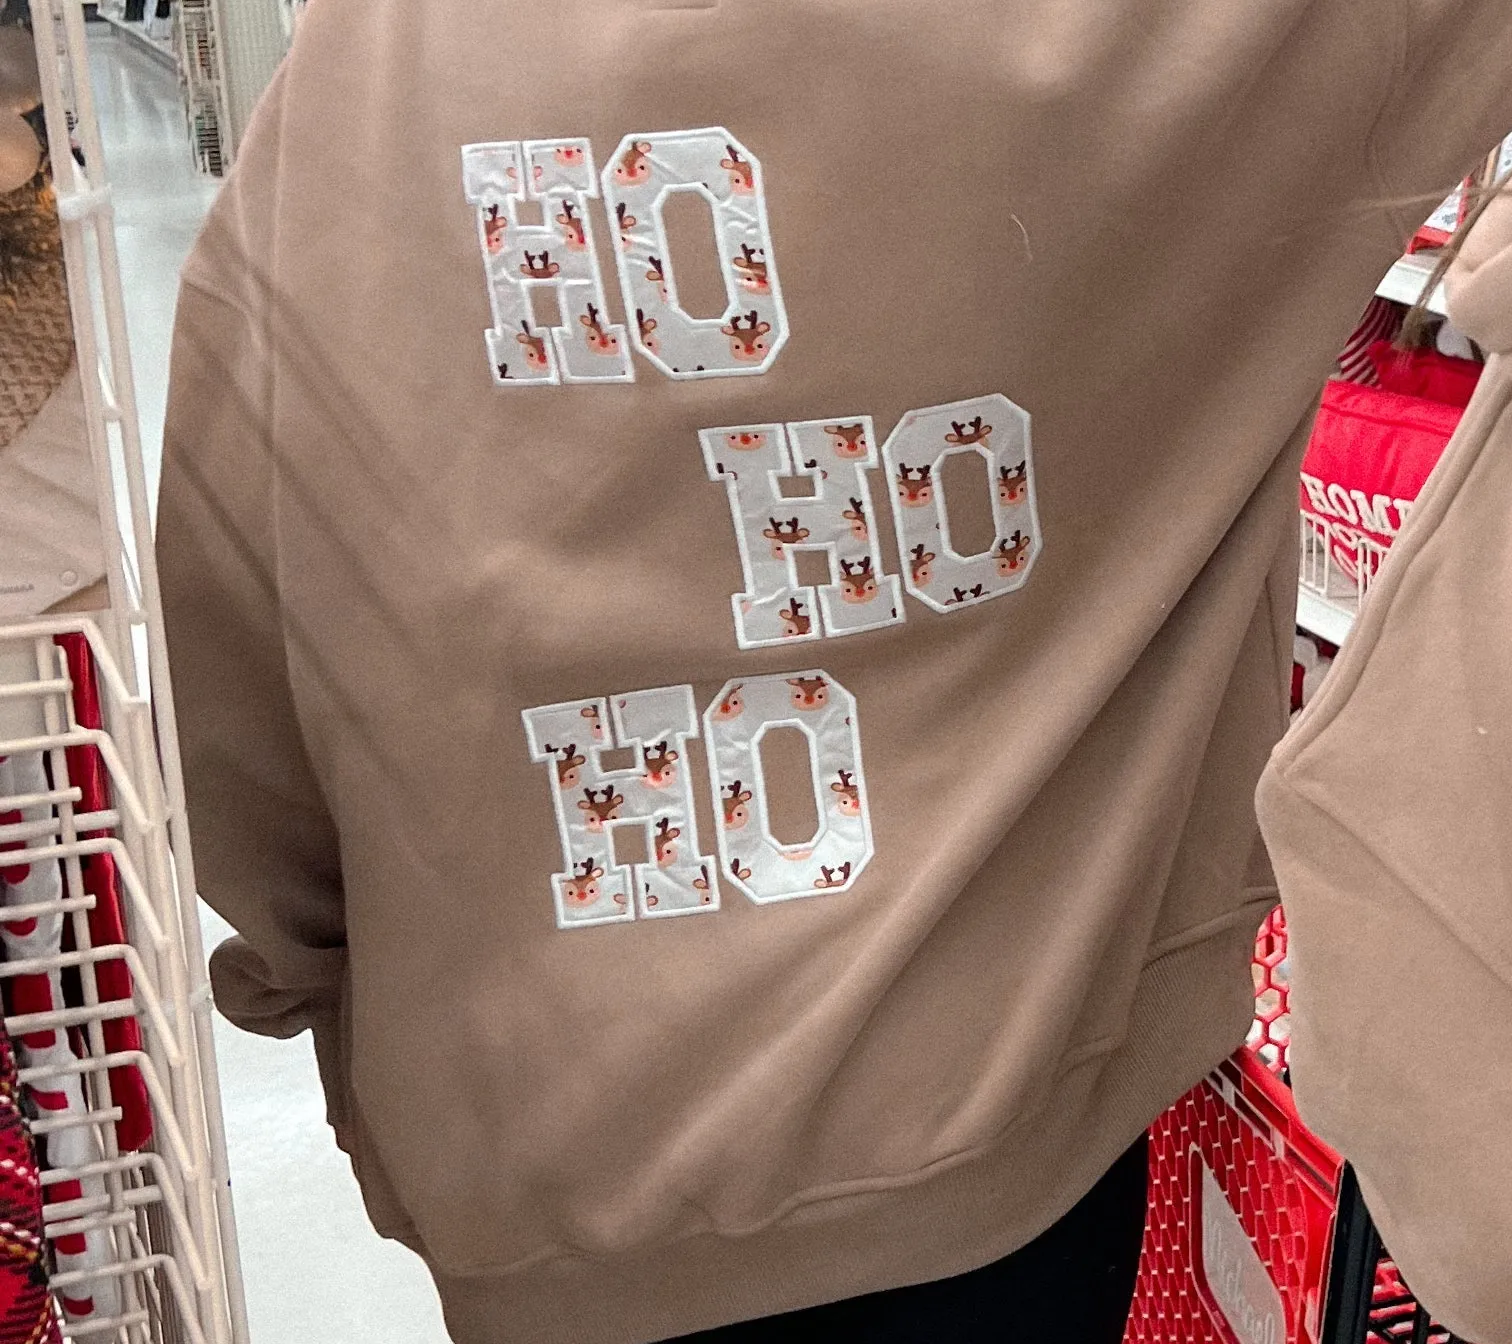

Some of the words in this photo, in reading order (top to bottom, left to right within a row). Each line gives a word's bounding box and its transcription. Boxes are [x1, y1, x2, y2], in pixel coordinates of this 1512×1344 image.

[461, 125, 790, 386] HO
[698, 392, 1044, 651] HO
[522, 667, 876, 931] HO
